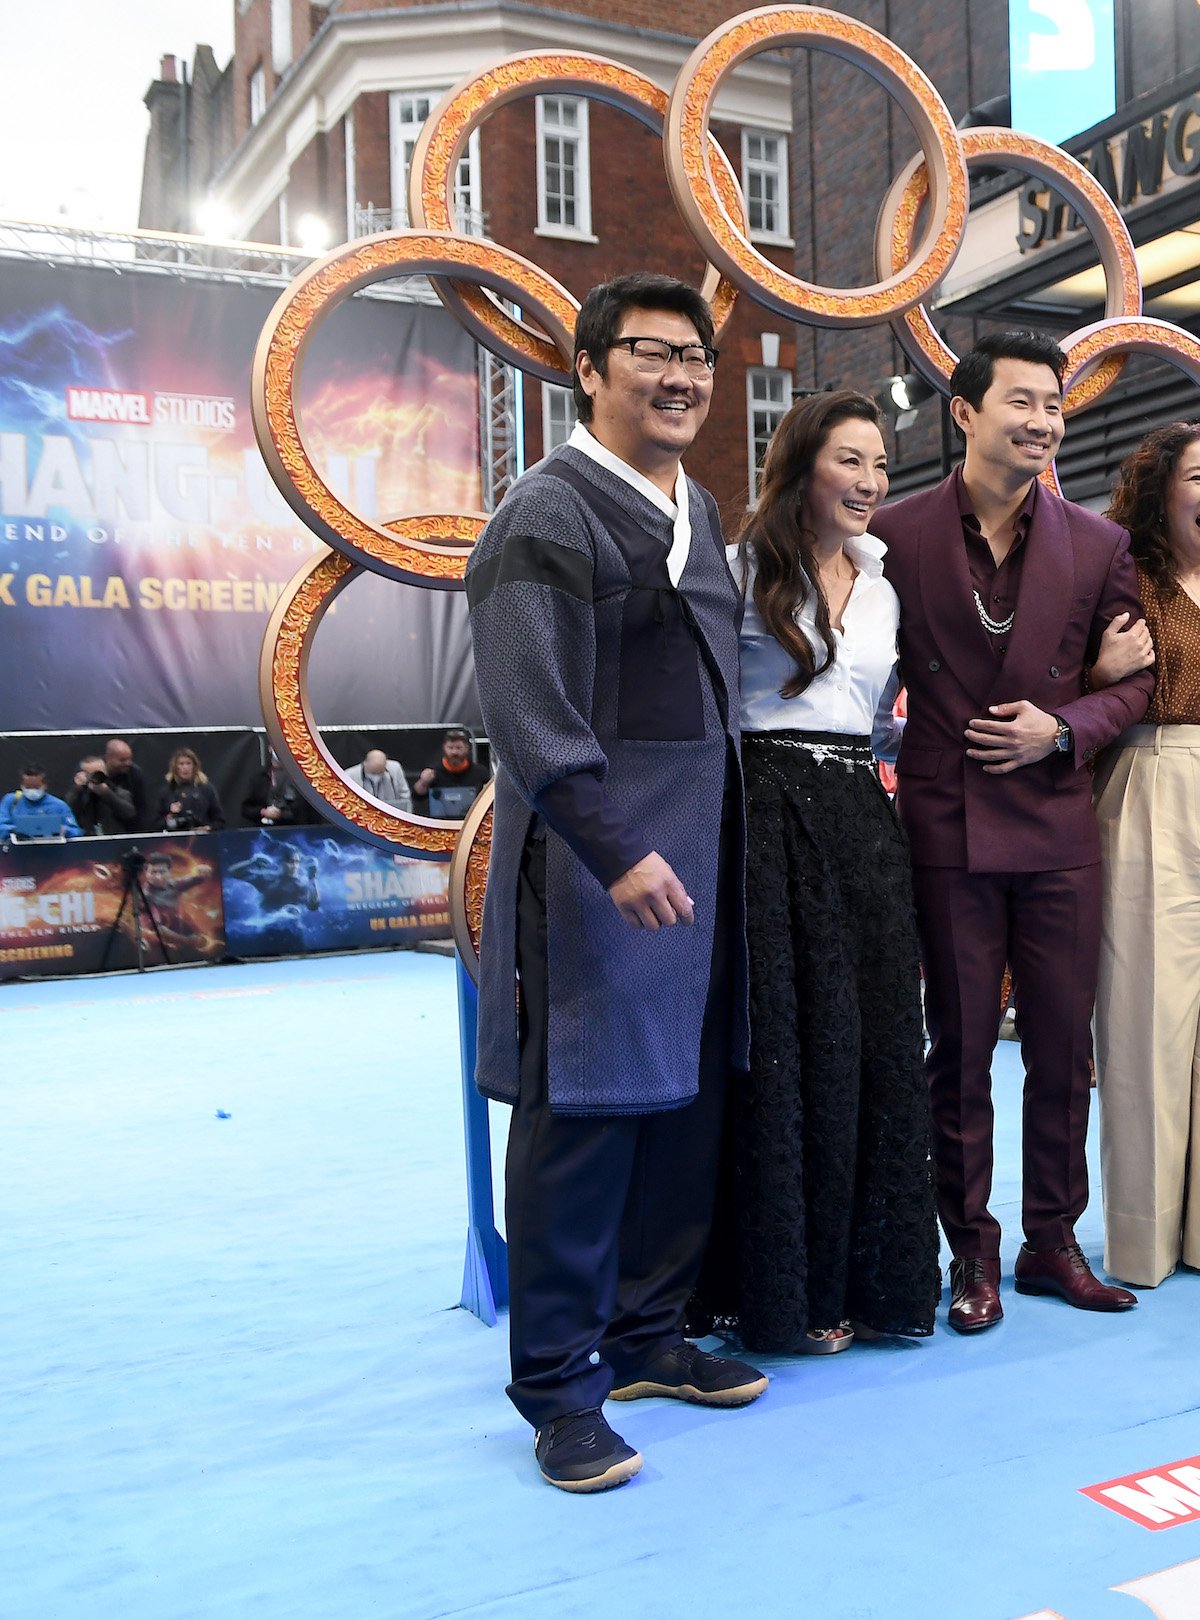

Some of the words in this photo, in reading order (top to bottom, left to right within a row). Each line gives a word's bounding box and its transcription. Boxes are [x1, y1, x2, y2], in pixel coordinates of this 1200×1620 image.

[69, 389, 150, 423] MARVEL
[154, 396, 235, 429] STUDIOS
[26, 573, 131, 609] GALA
